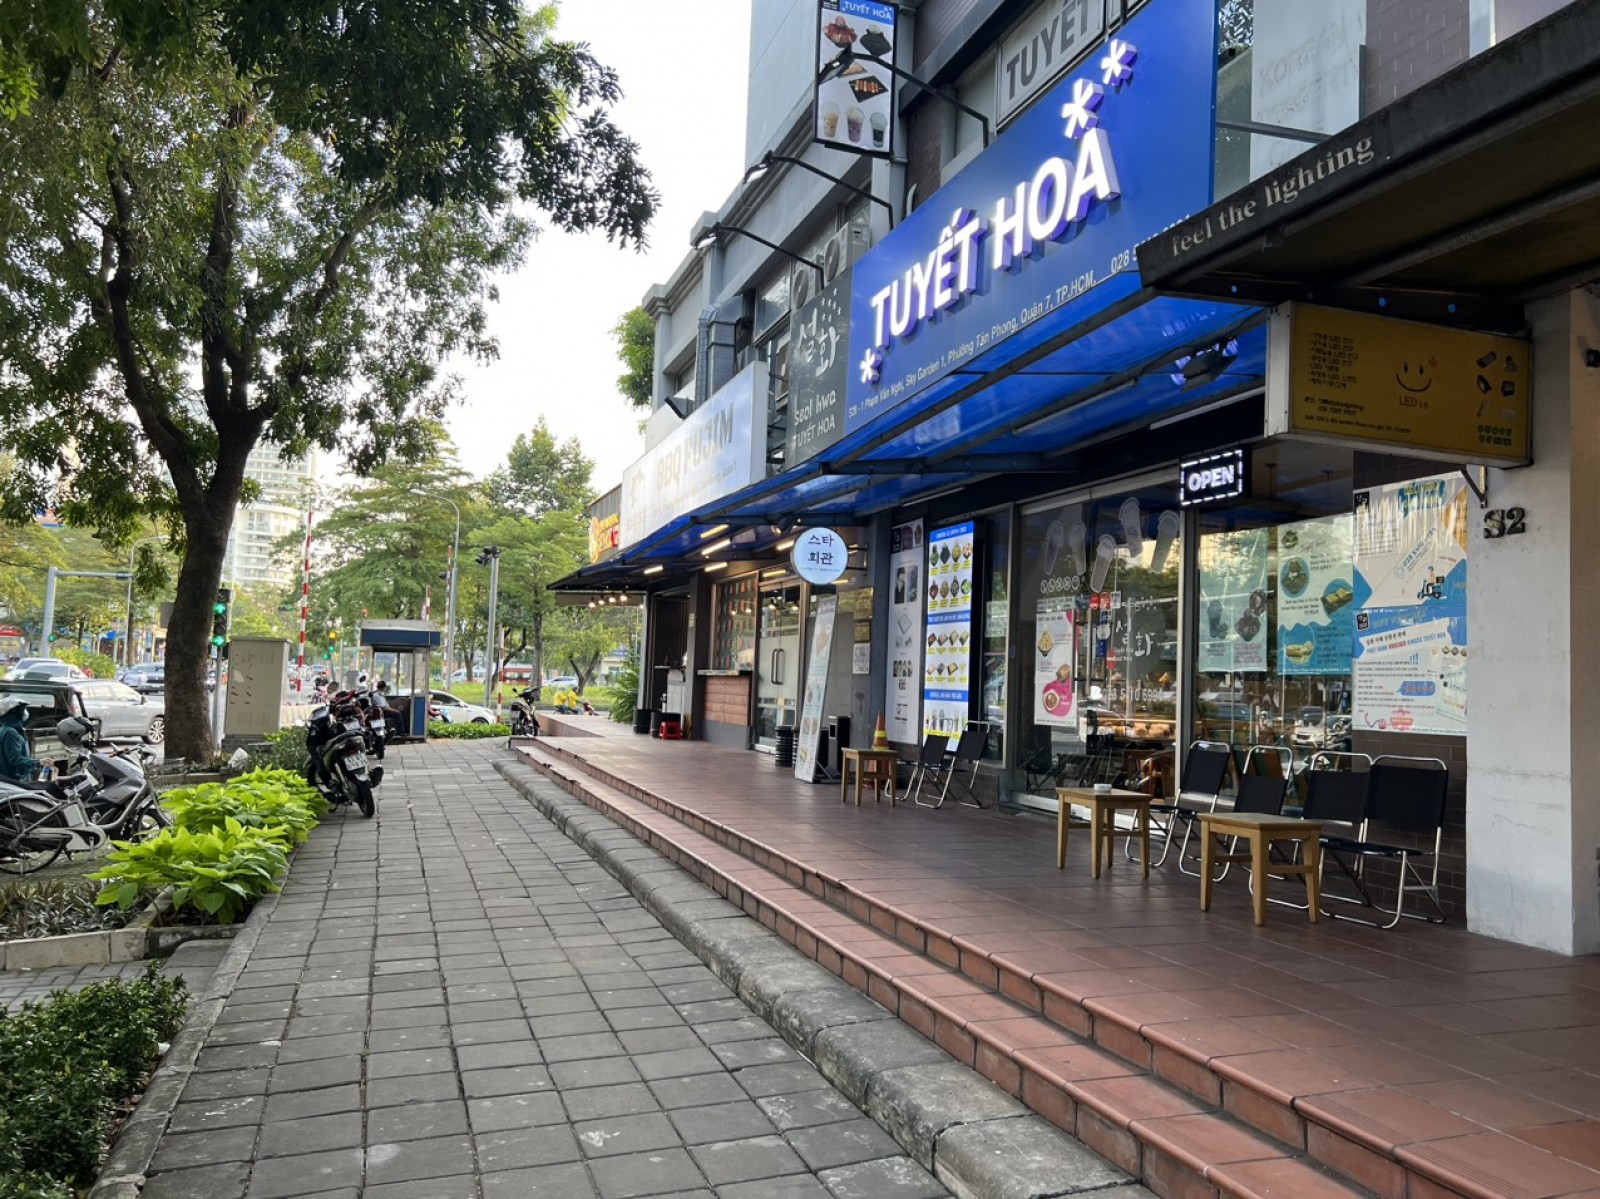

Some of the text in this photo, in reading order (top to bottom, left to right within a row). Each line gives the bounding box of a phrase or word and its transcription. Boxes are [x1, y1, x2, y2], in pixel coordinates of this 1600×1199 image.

[1171, 221, 1213, 257] feel
[1218, 199, 1257, 231] the
[1264, 136, 1375, 207] lighting
[871, 127, 1118, 348] TUYẾT HOA
[905, 373, 917, 388] Sky
[917, 361, 940, 381] Garden
[991, 316, 1018, 339] Phong,
[1021, 302, 1043, 324] Quận
[1111, 249, 1130, 273] 028
[816, 390, 836, 414] hwa
[1399, 394, 1417, 408] LED
[817, 414, 836, 437] HOA
[657, 444, 682, 491] BBQ
[1188, 464, 1235, 491] OPEN
[808, 534, 834, 547] 스타
[808, 551, 834, 565] 회관
